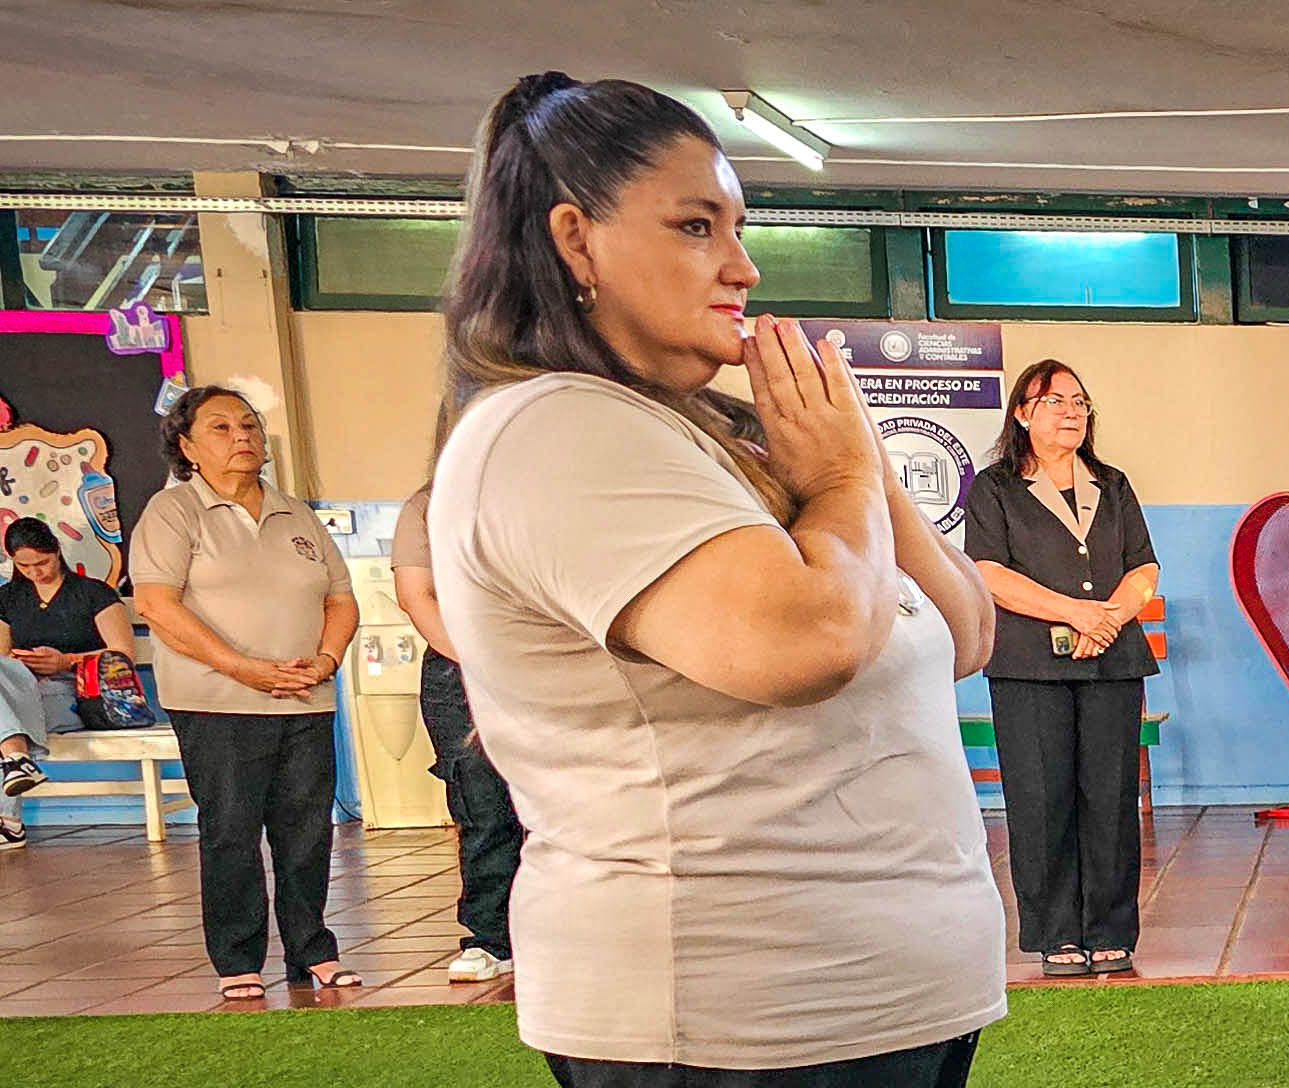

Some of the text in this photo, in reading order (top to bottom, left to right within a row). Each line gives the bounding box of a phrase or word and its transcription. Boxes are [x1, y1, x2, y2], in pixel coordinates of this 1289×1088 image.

[885, 379, 902, 389] EN
[905, 380, 962, 391] PROCESO
[964, 380, 981, 391] DE
[897, 419, 937, 434] PRIVADA
[937, 429, 953, 446] DEL
[953, 442, 970, 466] ESTE
